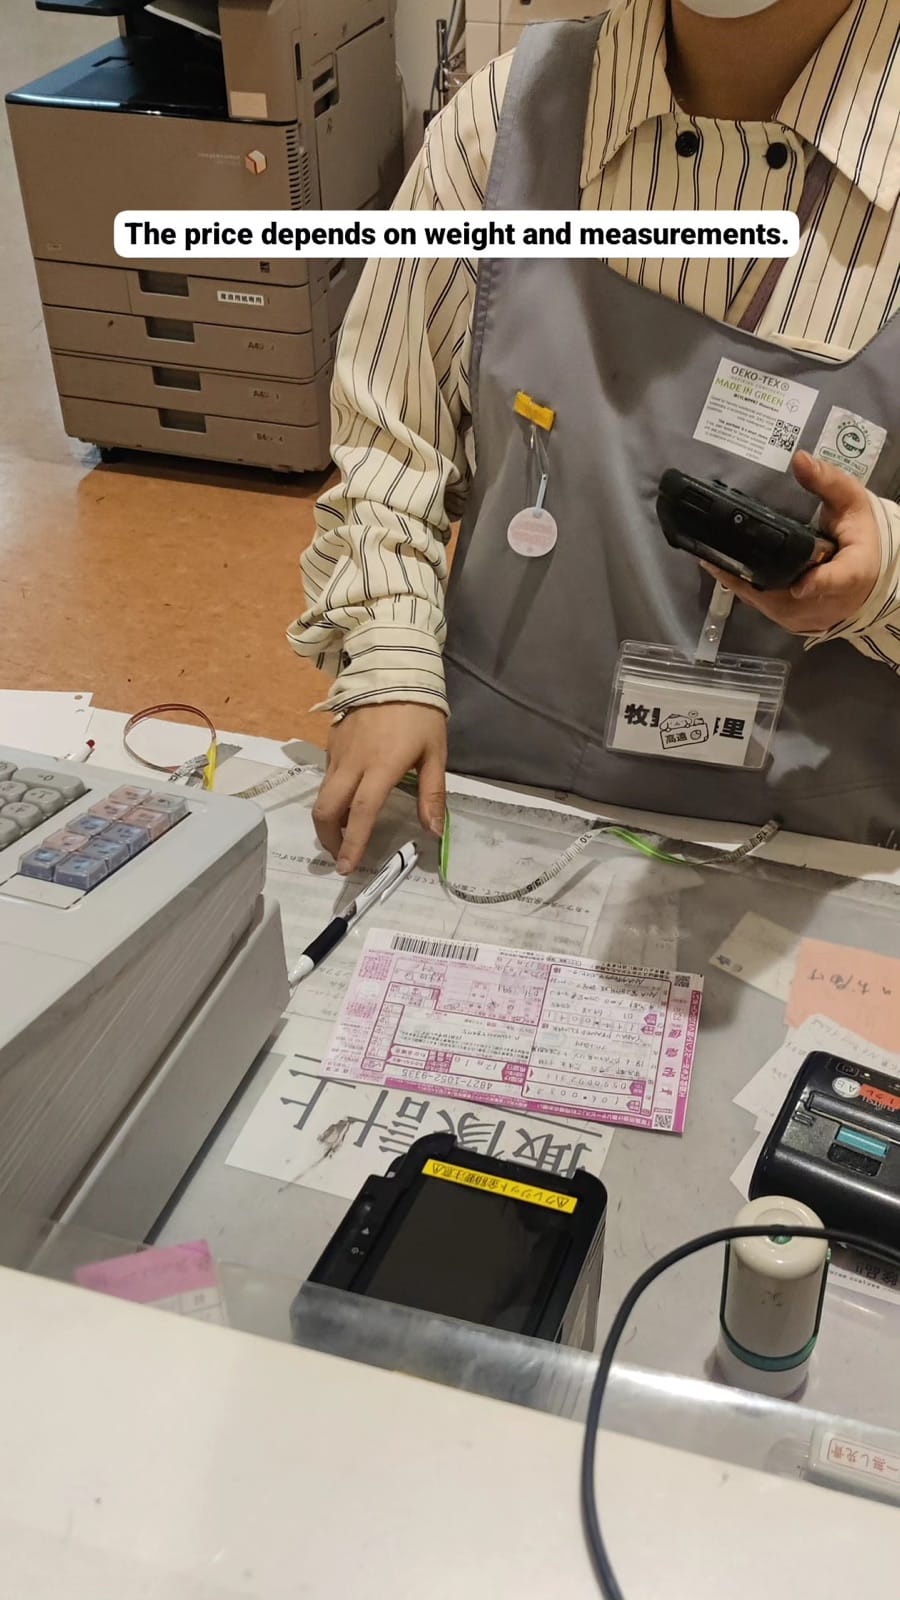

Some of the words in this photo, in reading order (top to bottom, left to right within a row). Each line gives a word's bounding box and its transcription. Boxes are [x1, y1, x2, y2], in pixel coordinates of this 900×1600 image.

[715, 377, 742, 393] MADE
[742, 384, 753, 397] IN
[753, 389, 785, 407] GREEN
[400, 1067, 494, 1090] 4827-1052-9335
